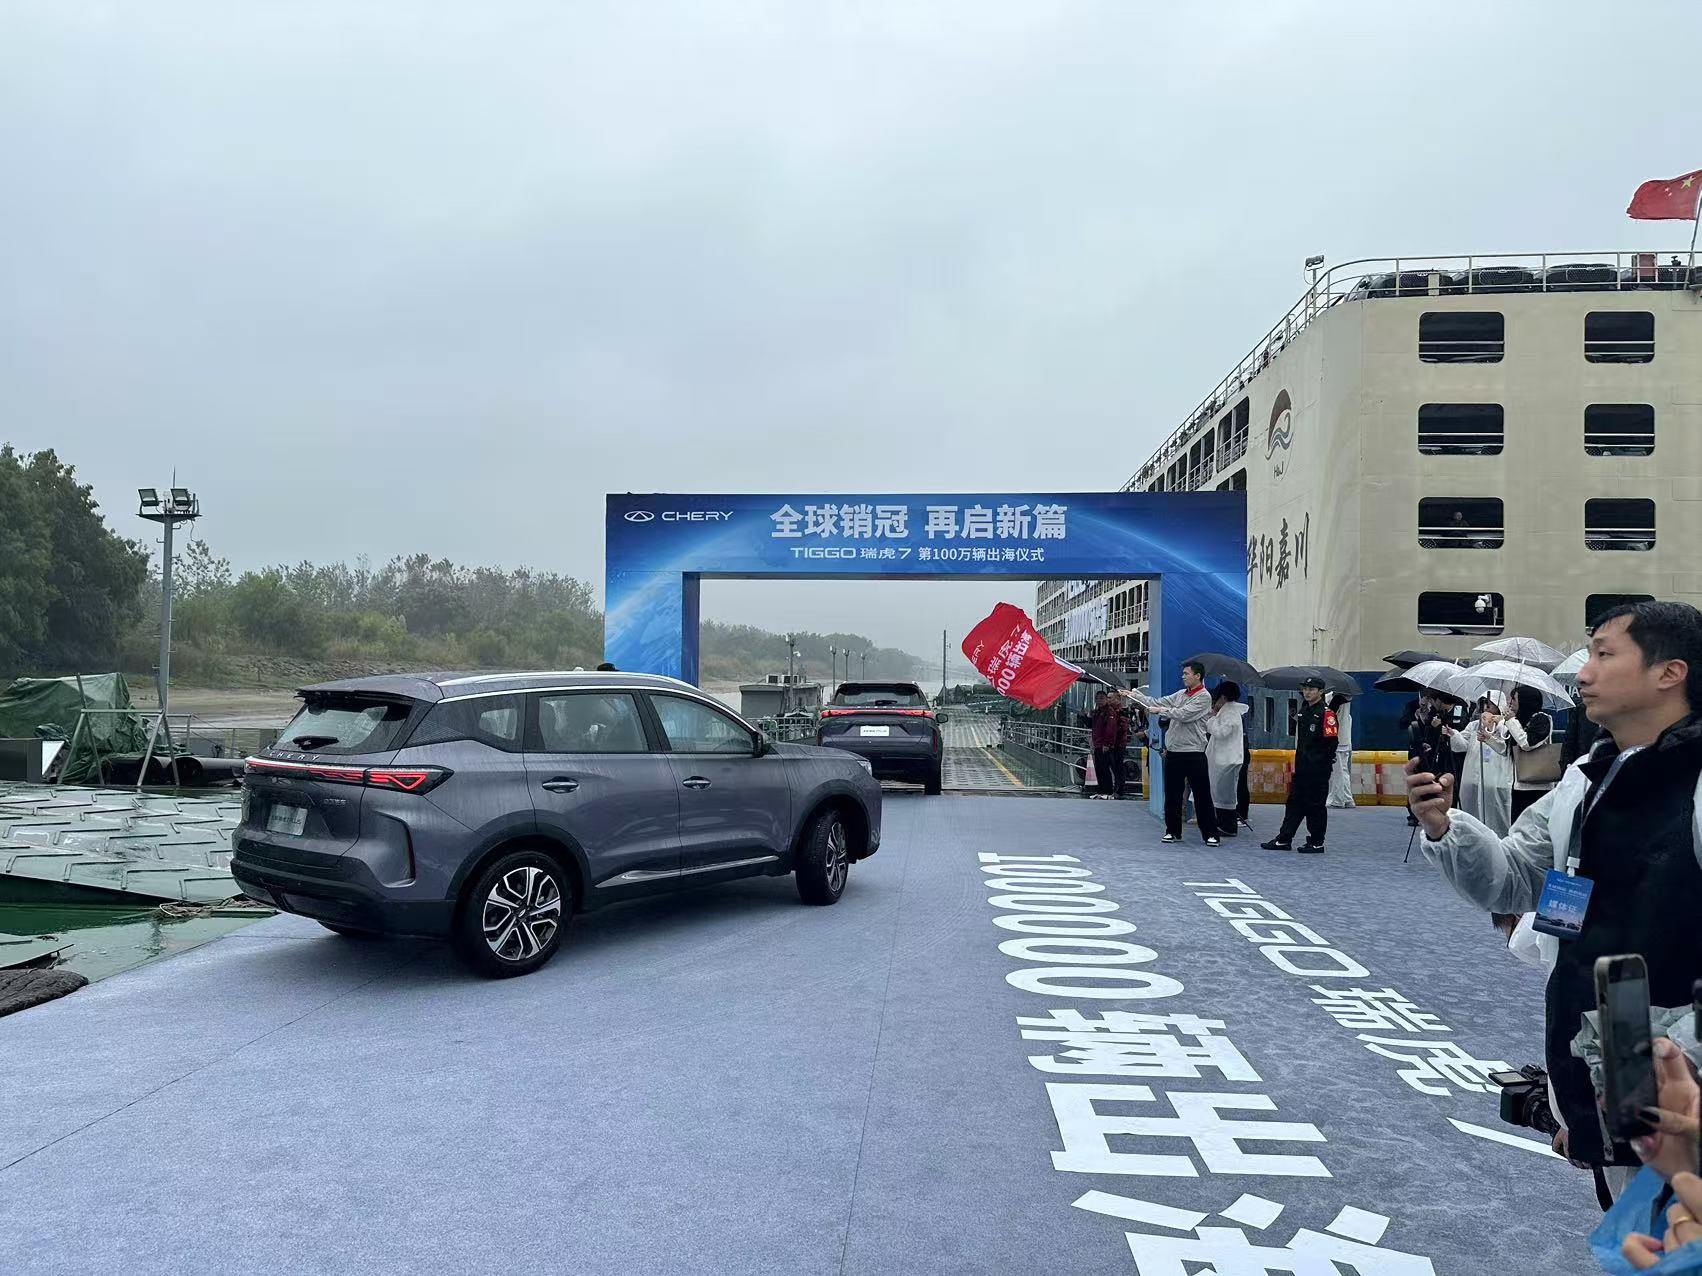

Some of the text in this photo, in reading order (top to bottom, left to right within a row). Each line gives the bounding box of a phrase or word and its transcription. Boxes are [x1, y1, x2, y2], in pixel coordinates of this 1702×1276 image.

[661, 511, 734, 521] CHERY
[769, 503, 1068, 540] 全球销冠 再启新篇
[790, 547, 1045, 562] TIGGO 瑞虎7 第100万辆出海仪式
[269, 751, 320, 761] CHERY
[1183, 878, 1371, 978] TIGGO
